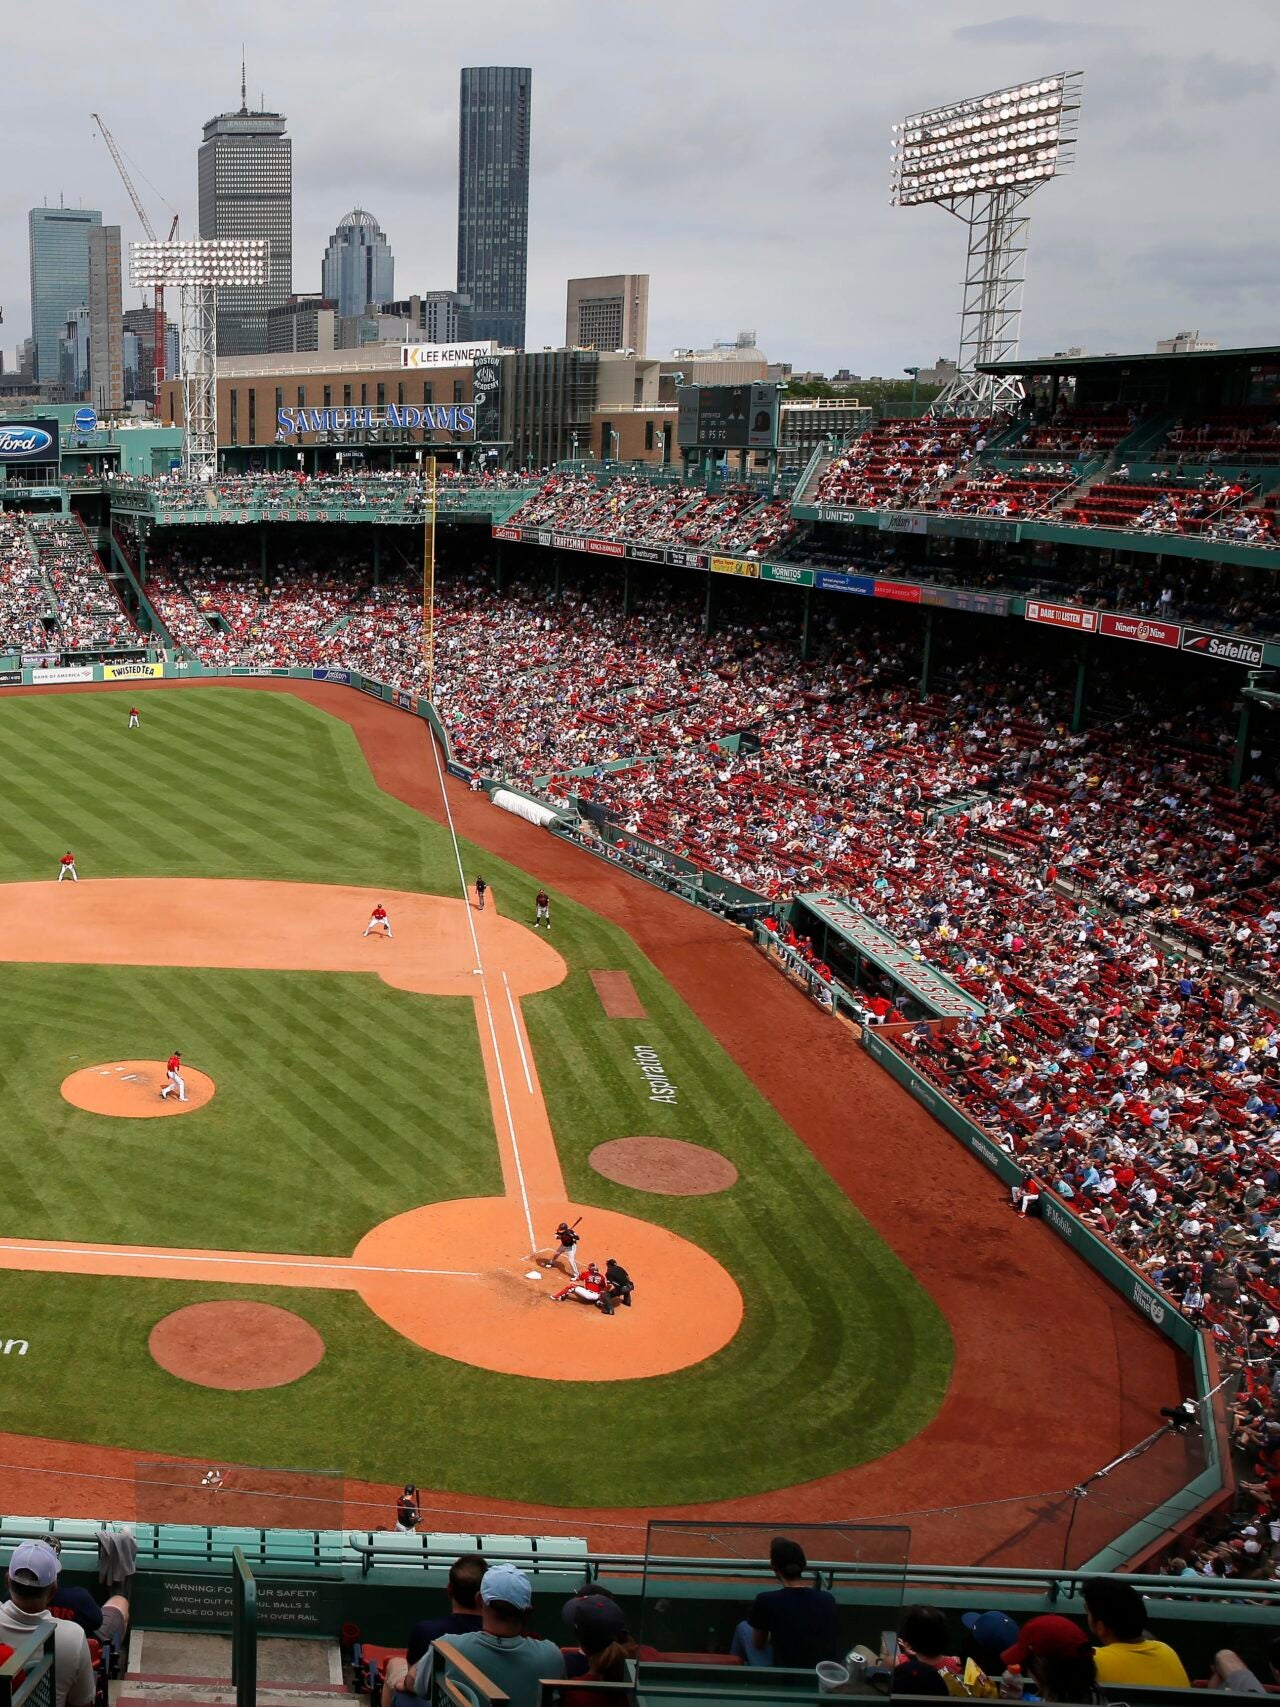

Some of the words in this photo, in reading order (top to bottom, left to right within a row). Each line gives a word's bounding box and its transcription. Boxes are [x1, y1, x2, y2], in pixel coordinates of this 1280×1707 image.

[420, 350, 440, 362] LEE
[441, 348, 488, 362] KENNEDY
[474, 358, 500, 366] BOSTON
[473, 380, 498, 390] ACADEMY
[278, 407, 383, 436] SAMUEL
[384, 403, 474, 432] ADAMS
[220, 512, 233, 522] 27
[336, 511, 346, 520] 42
[826, 511, 854, 522] UNITED
[554, 536, 585, 549] CRAFTSMAN
[772, 566, 801, 578] HORNITOS
[1040, 608, 1054, 618] DARE
[1055, 610, 1061, 619] TO
[1062, 611, 1080, 624] LISTEN
[1115, 622, 1137, 635] Ninety
[1149, 628, 1165, 639] Nine
[1208, 638, 1260, 663] Safelite
[112, 665, 142, 678] TWISTED
[142, 665, 155, 676] TEA
[824, 910, 866, 931] SOX
[853, 933, 902, 957] RED
[888, 960, 975, 1014] BOSTON
[632, 1045, 678, 1104] Aspiration
[1134, 1282, 1153, 1304] Ninety
[1133, 1290, 1150, 1313] Nine
[164, 1582, 216, 1593] WARNING:
[163, 1607, 198, 1615] PLEASE
